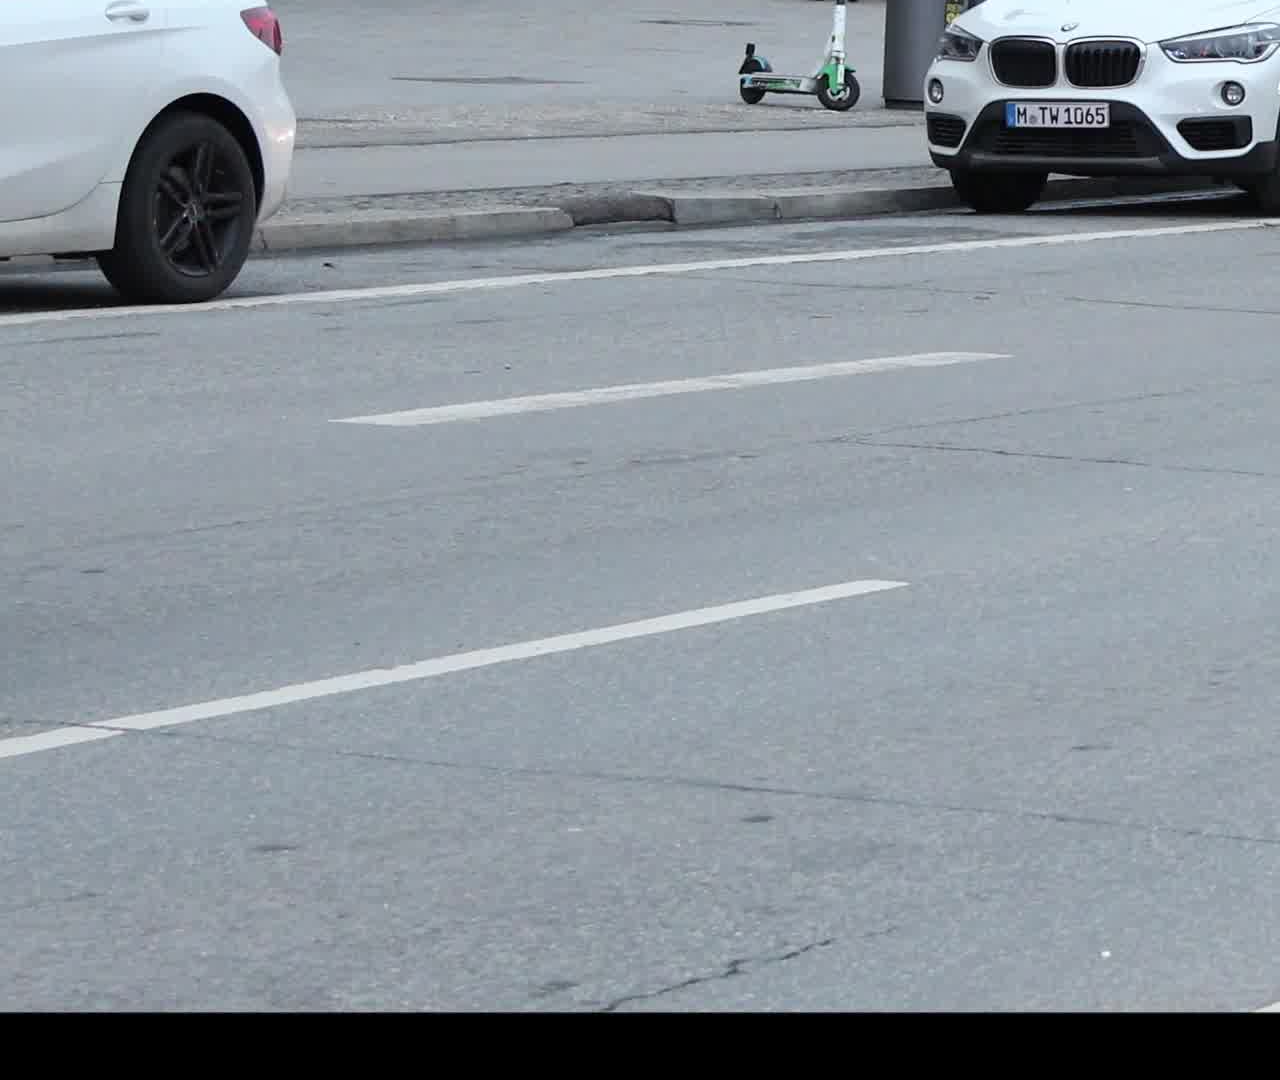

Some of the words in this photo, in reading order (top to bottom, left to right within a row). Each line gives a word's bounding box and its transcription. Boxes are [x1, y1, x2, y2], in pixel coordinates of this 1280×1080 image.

[1016, 106, 1027, 125] M
[1038, 106, 1060, 125] TW
[1063, 107, 1106, 125] 1065
